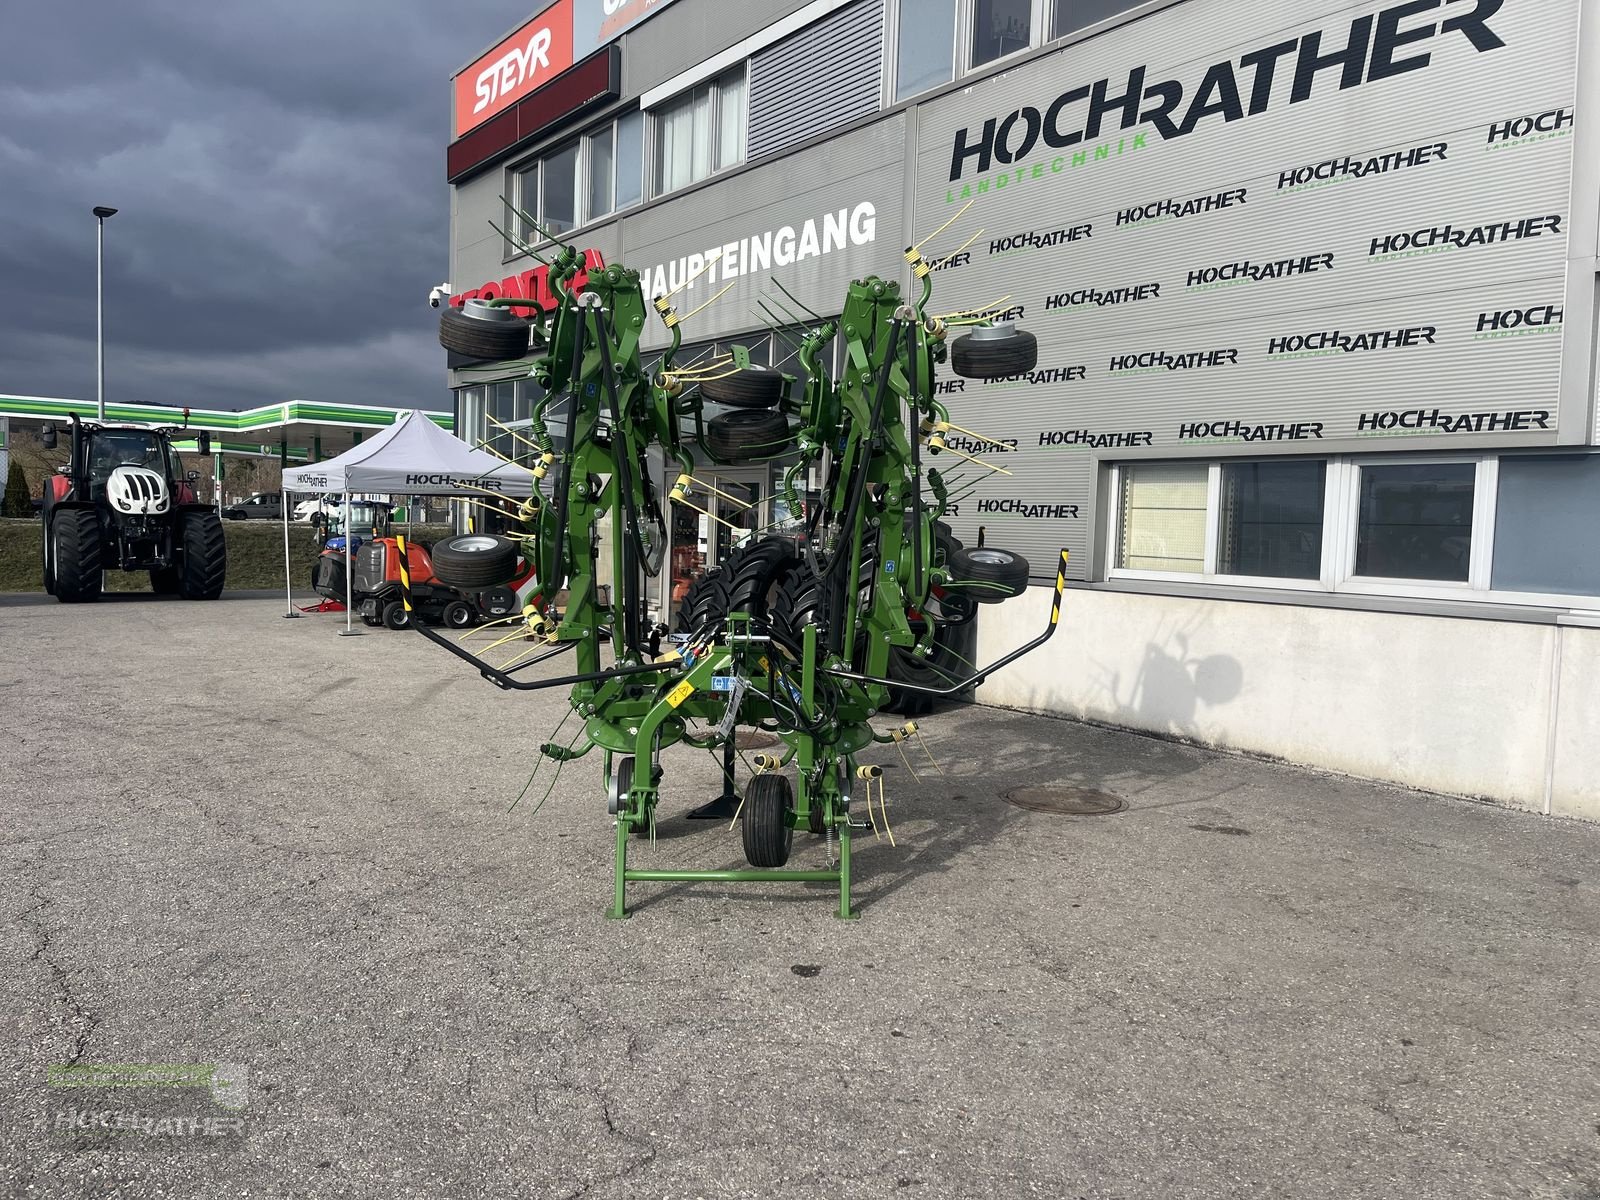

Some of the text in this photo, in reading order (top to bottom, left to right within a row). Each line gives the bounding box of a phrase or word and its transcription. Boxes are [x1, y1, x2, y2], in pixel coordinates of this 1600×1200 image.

[473, 27, 552, 115] STEYR
[949, 0, 1507, 182] HOCHRATHER
[944, 129, 1149, 204] LANDTECHNIK
[1277, 142, 1448, 190] HOCHRATHER
[1115, 188, 1248, 226] HOCHRATHER
[638, 201, 877, 301] HAUPTEINGANG
[989, 223, 1093, 255] HOCHRATHER
[1368, 215, 1562, 256] HOCHRATHER
[1186, 253, 1335, 287] HOCHRATHER
[1045, 283, 1161, 310] HOCHRATHER
[1267, 326, 1436, 355] HOCHRATHER
[1109, 348, 1238, 371] HOCHRATHER
[1178, 420, 1324, 442] HOCHRATHER
[1357, 408, 1549, 433] HOCHRATHER
[1038, 429, 1153, 449] HOCHRATHER
[405, 474, 503, 491] HOCHRATHER
[977, 499, 1079, 519] HOCHRATHER
